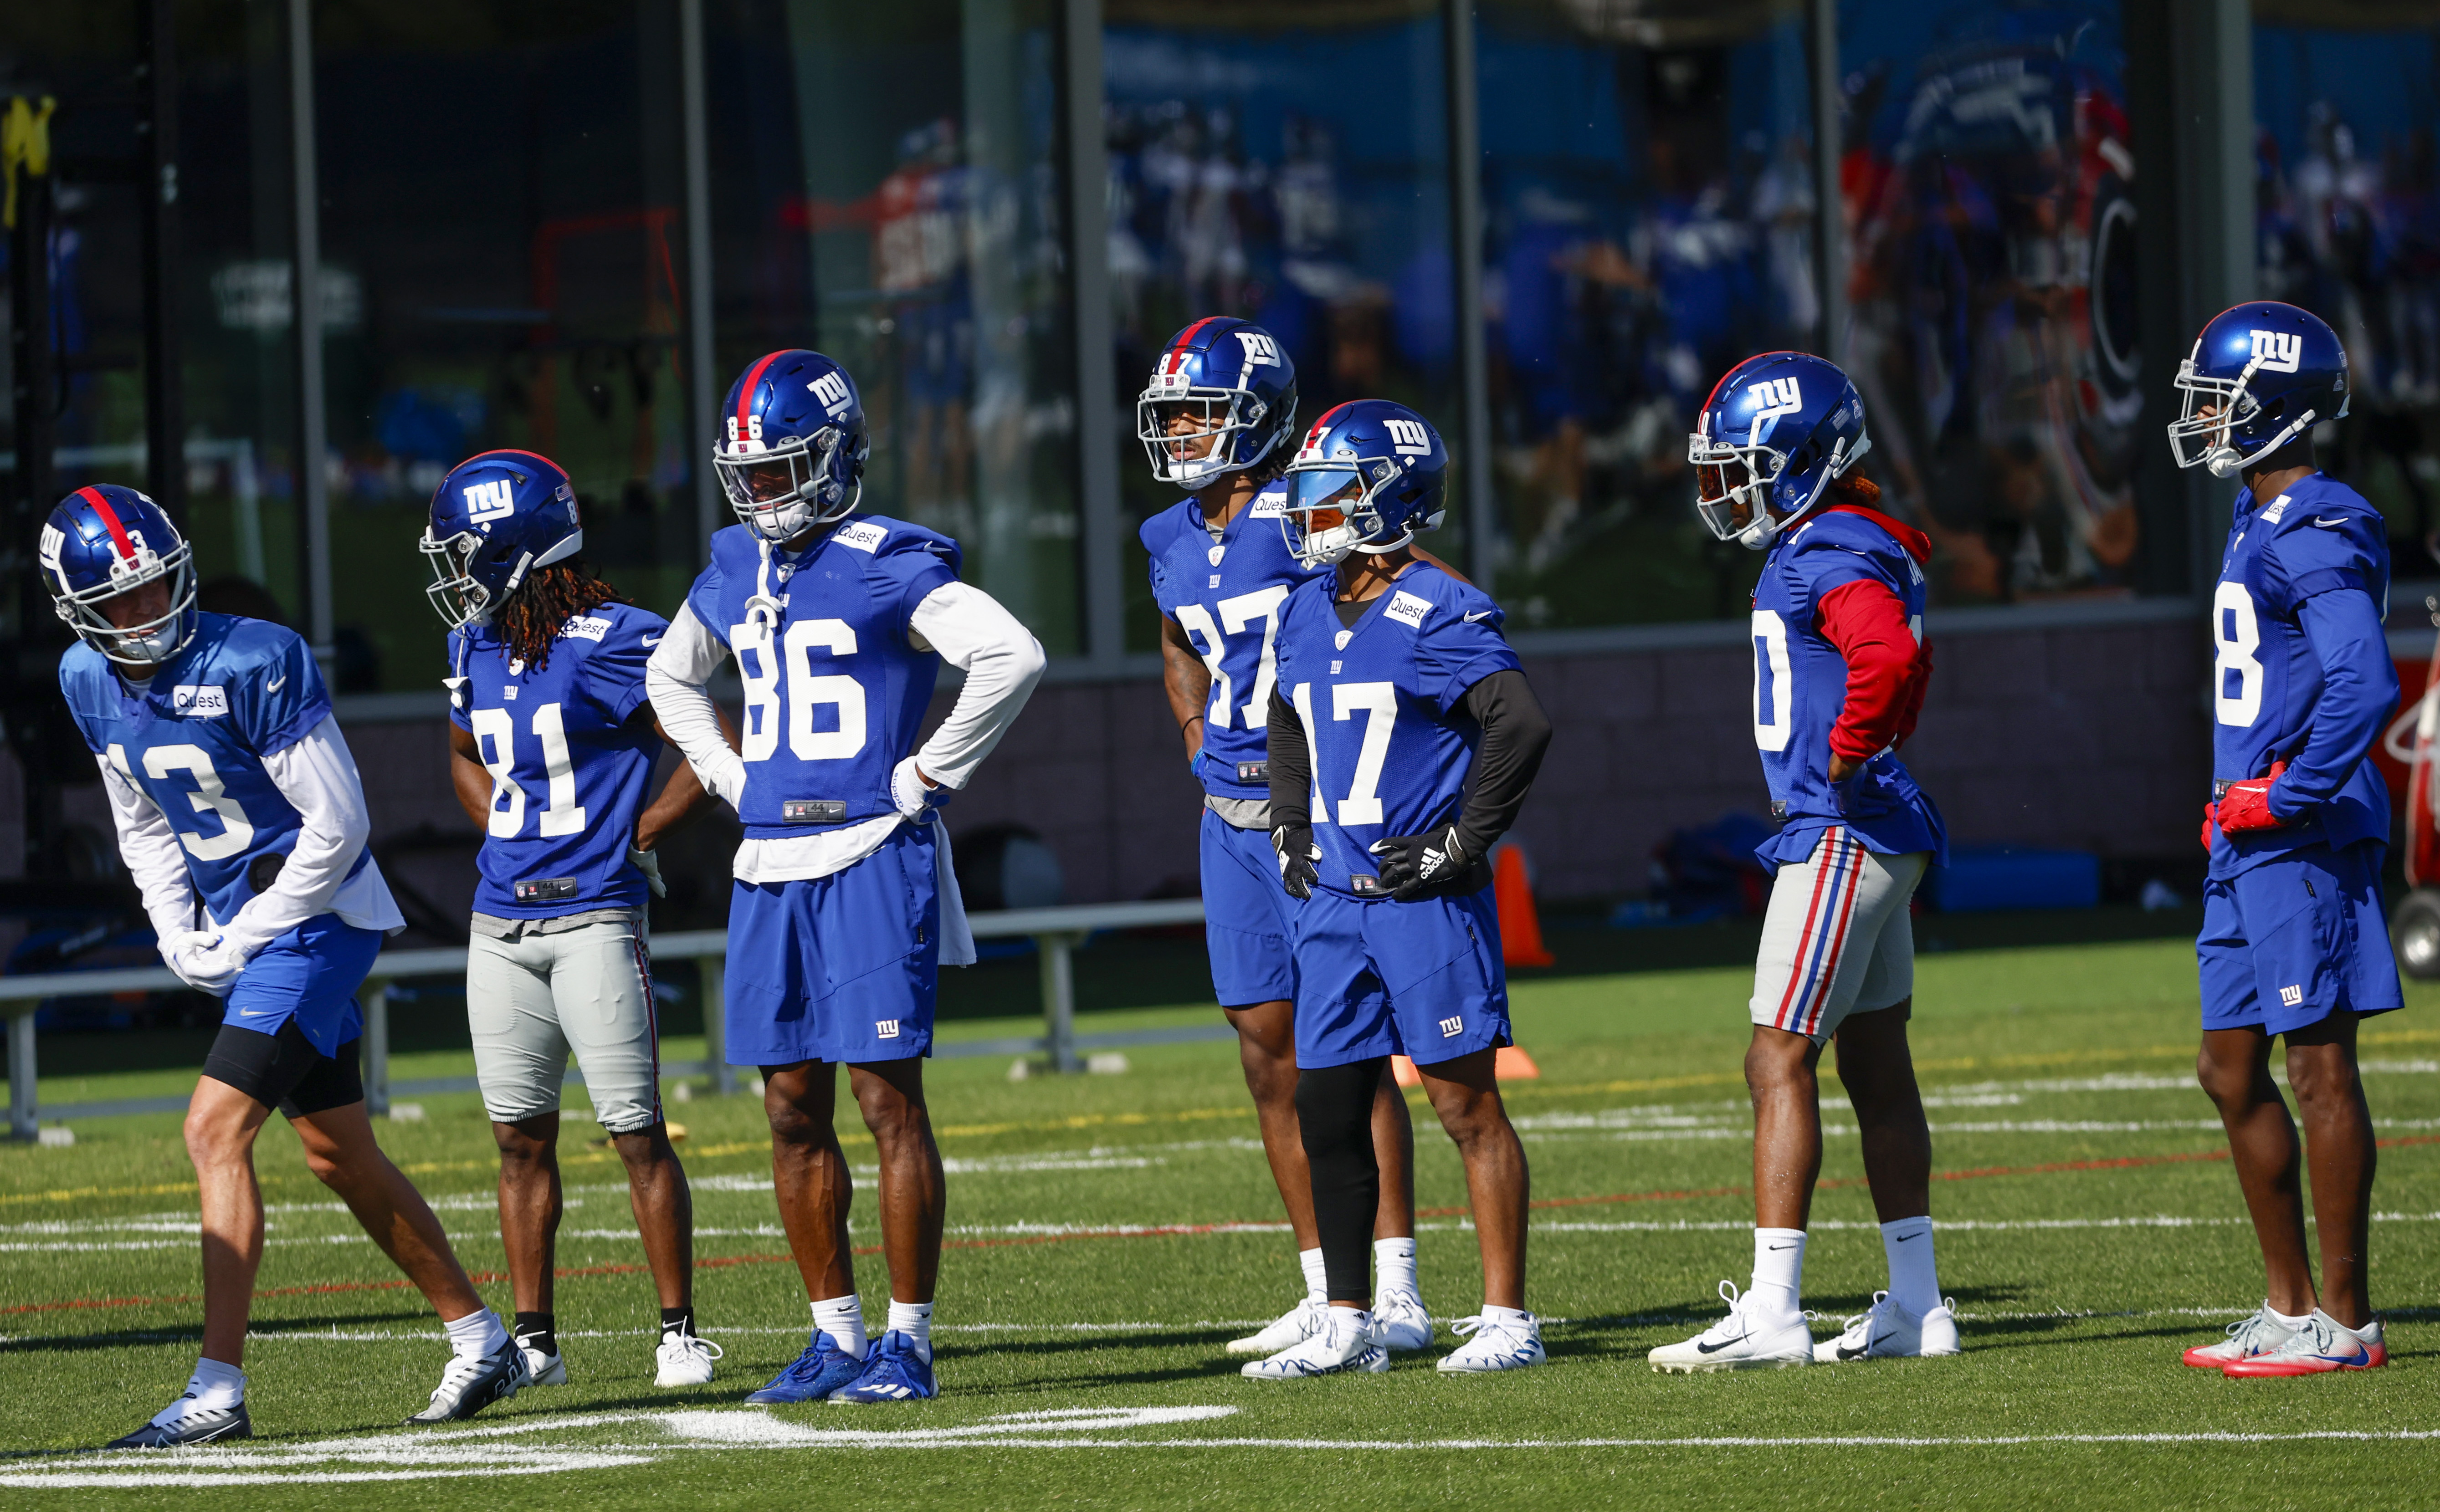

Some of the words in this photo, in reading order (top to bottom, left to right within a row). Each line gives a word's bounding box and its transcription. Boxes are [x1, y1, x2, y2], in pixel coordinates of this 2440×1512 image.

[1158, 353, 1194, 375] 87
[1234, 333, 1281, 368] ny
[2249, 329, 2302, 373] ny
[806, 371, 853, 417] ny
[1747, 377, 1803, 421] ny
[728, 415, 762, 440] 86
[1301, 427, 1331, 450] 17
[1383, 419, 1432, 456] ny
[464, 480, 515, 524] ny
[1255, 498, 1287, 511] Ques
[40, 523, 66, 570] ny
[107, 530, 148, 563] 13
[839, 526, 878, 544] Quest
[1209, 574, 1221, 588] ny
[1391, 598, 1425, 620] Quest
[565, 621, 605, 634] Quest
[1175, 584, 1289, 730] 87
[1330, 660, 1343, 674] ny
[2213, 581, 2264, 727] 8
[178, 693, 222, 707] Quest
[504, 685, 519, 700] ny
[730, 618, 866, 761] 86
[1292, 681, 1398, 826] 17
[470, 702, 587, 838] 81
[106, 744, 255, 861] 13
[891, 772, 904, 807] adidas
[1420, 852, 1447, 879] adidas
[2280, 985, 2302, 1007] ny
[875, 1019, 899, 1038] ny
[1439, 1016, 1464, 1038] ny
